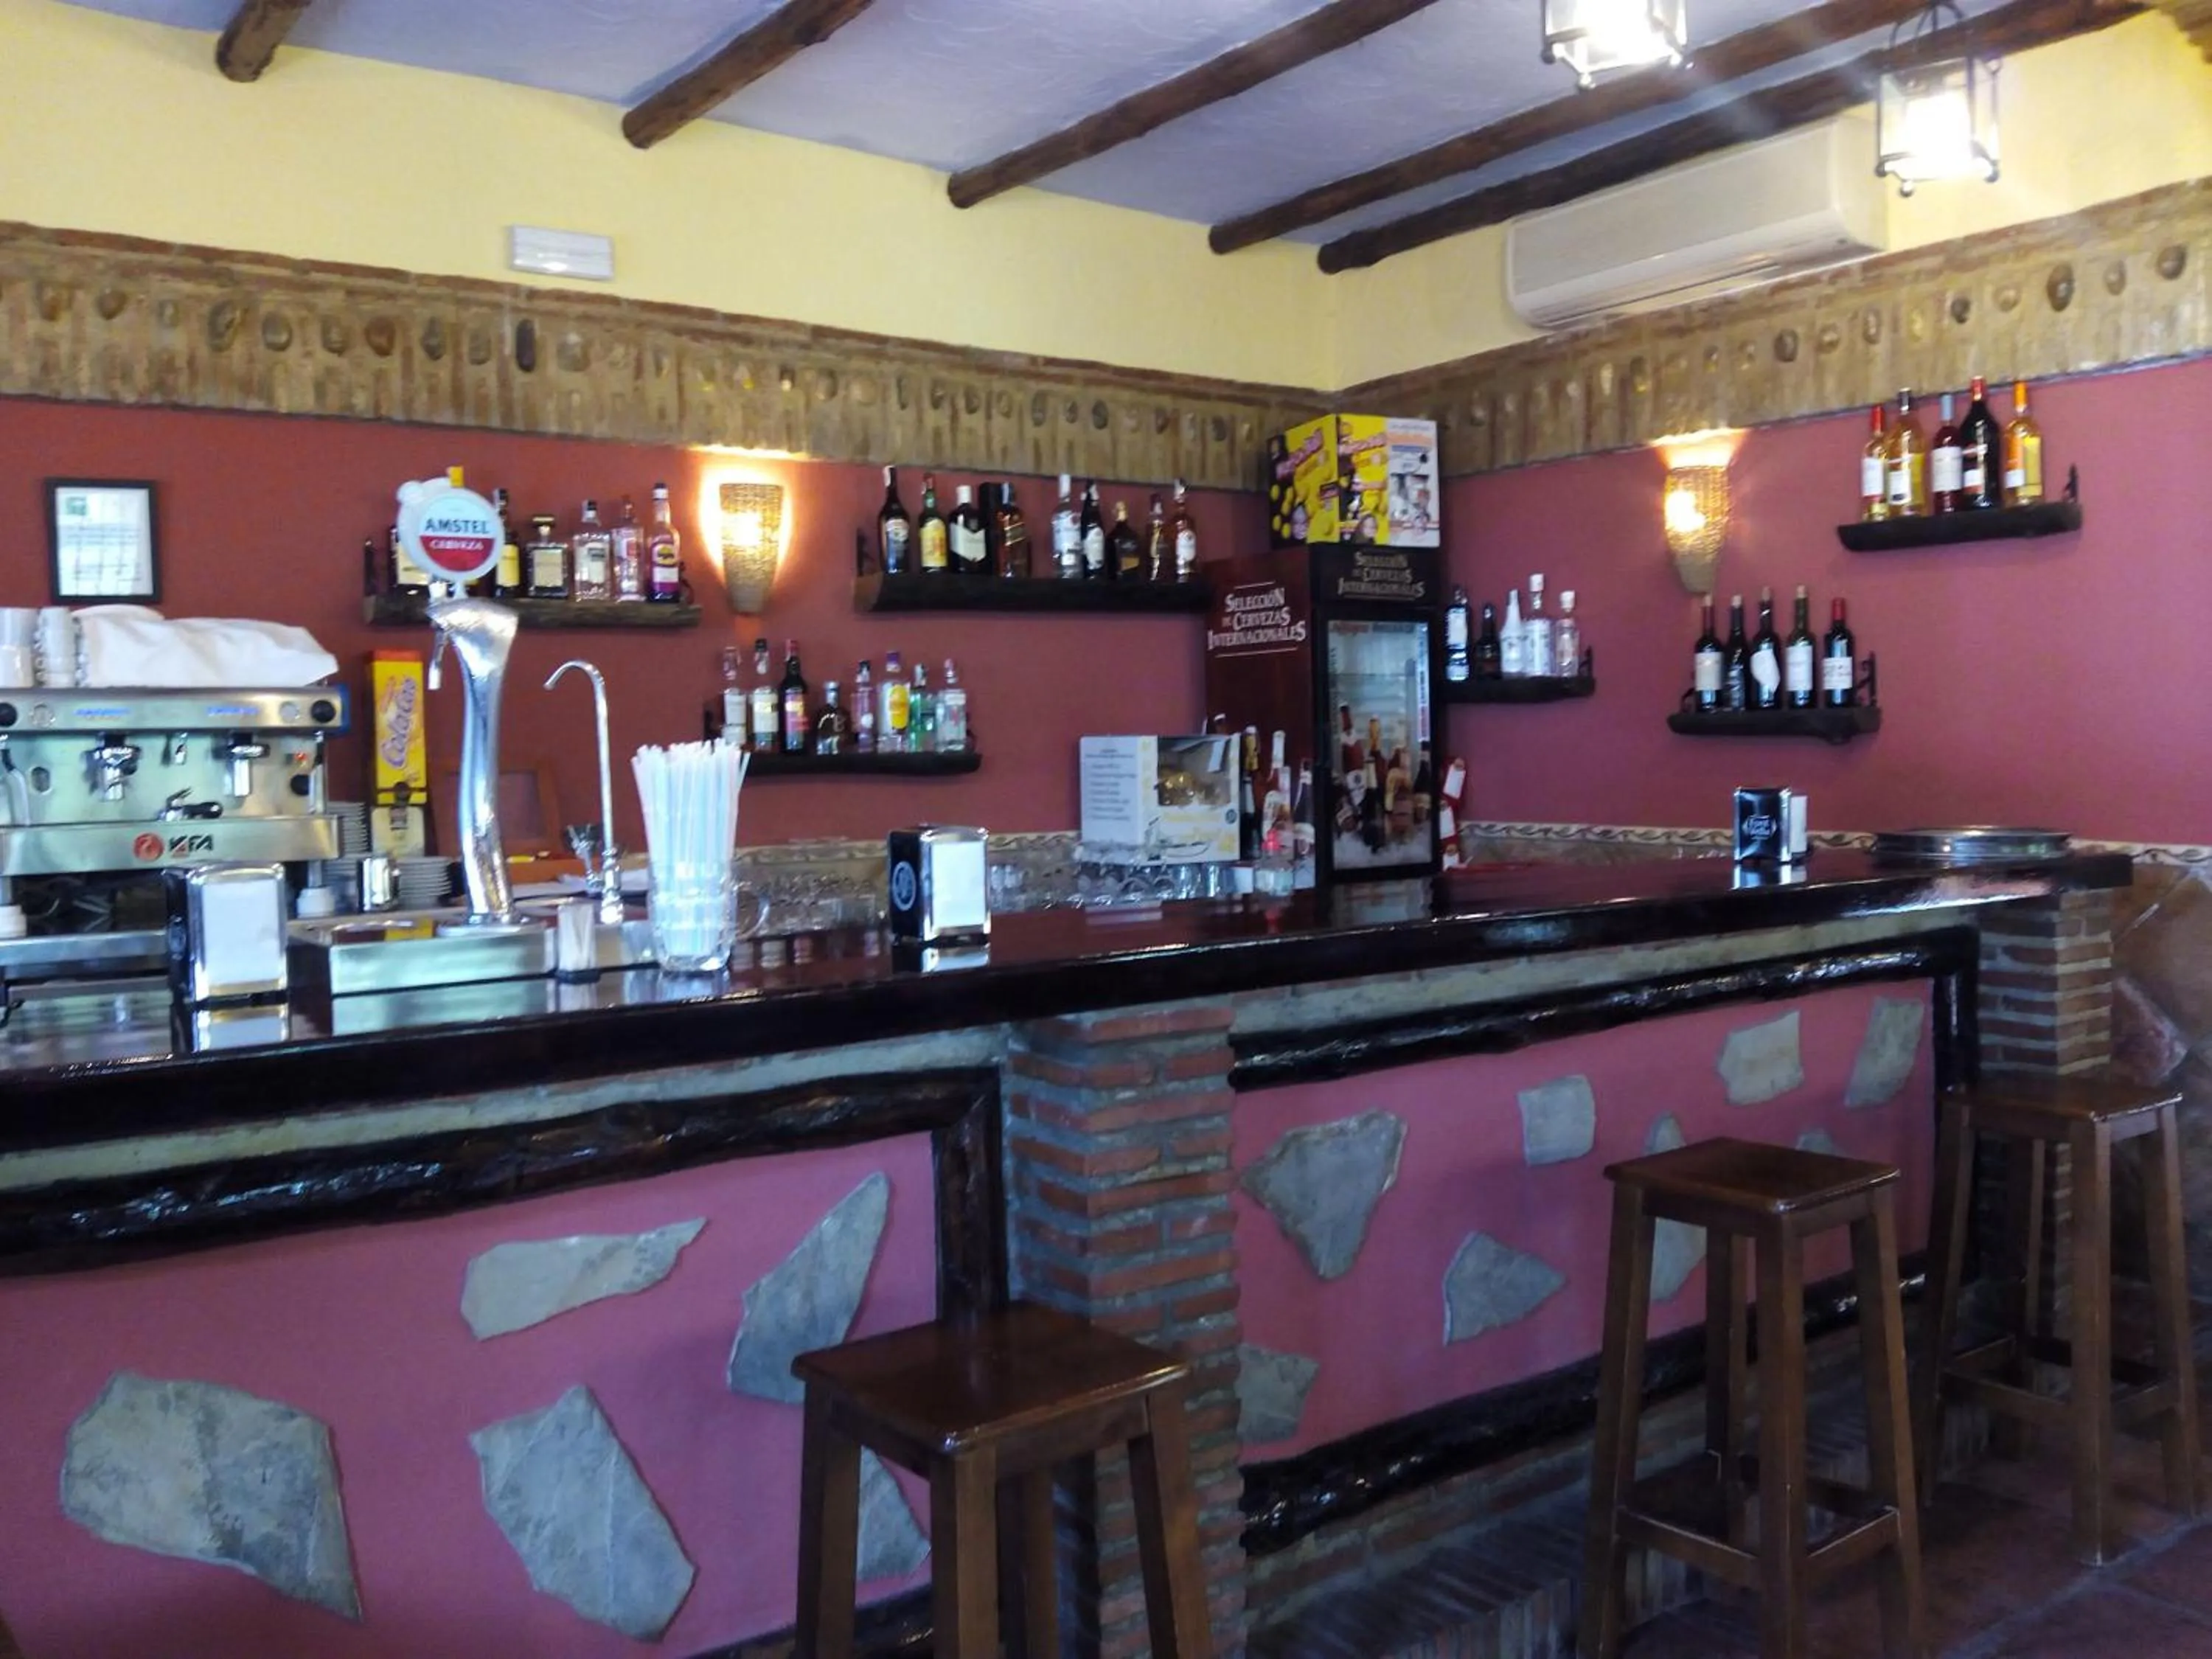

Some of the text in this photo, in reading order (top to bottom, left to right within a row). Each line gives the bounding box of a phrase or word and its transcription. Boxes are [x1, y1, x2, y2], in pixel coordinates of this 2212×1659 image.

[424, 518, 490, 535] AMSTEL
[1233, 606, 1290, 630] CERVEZAS
[1207, 621, 1307, 650] INTERNACIONALES
